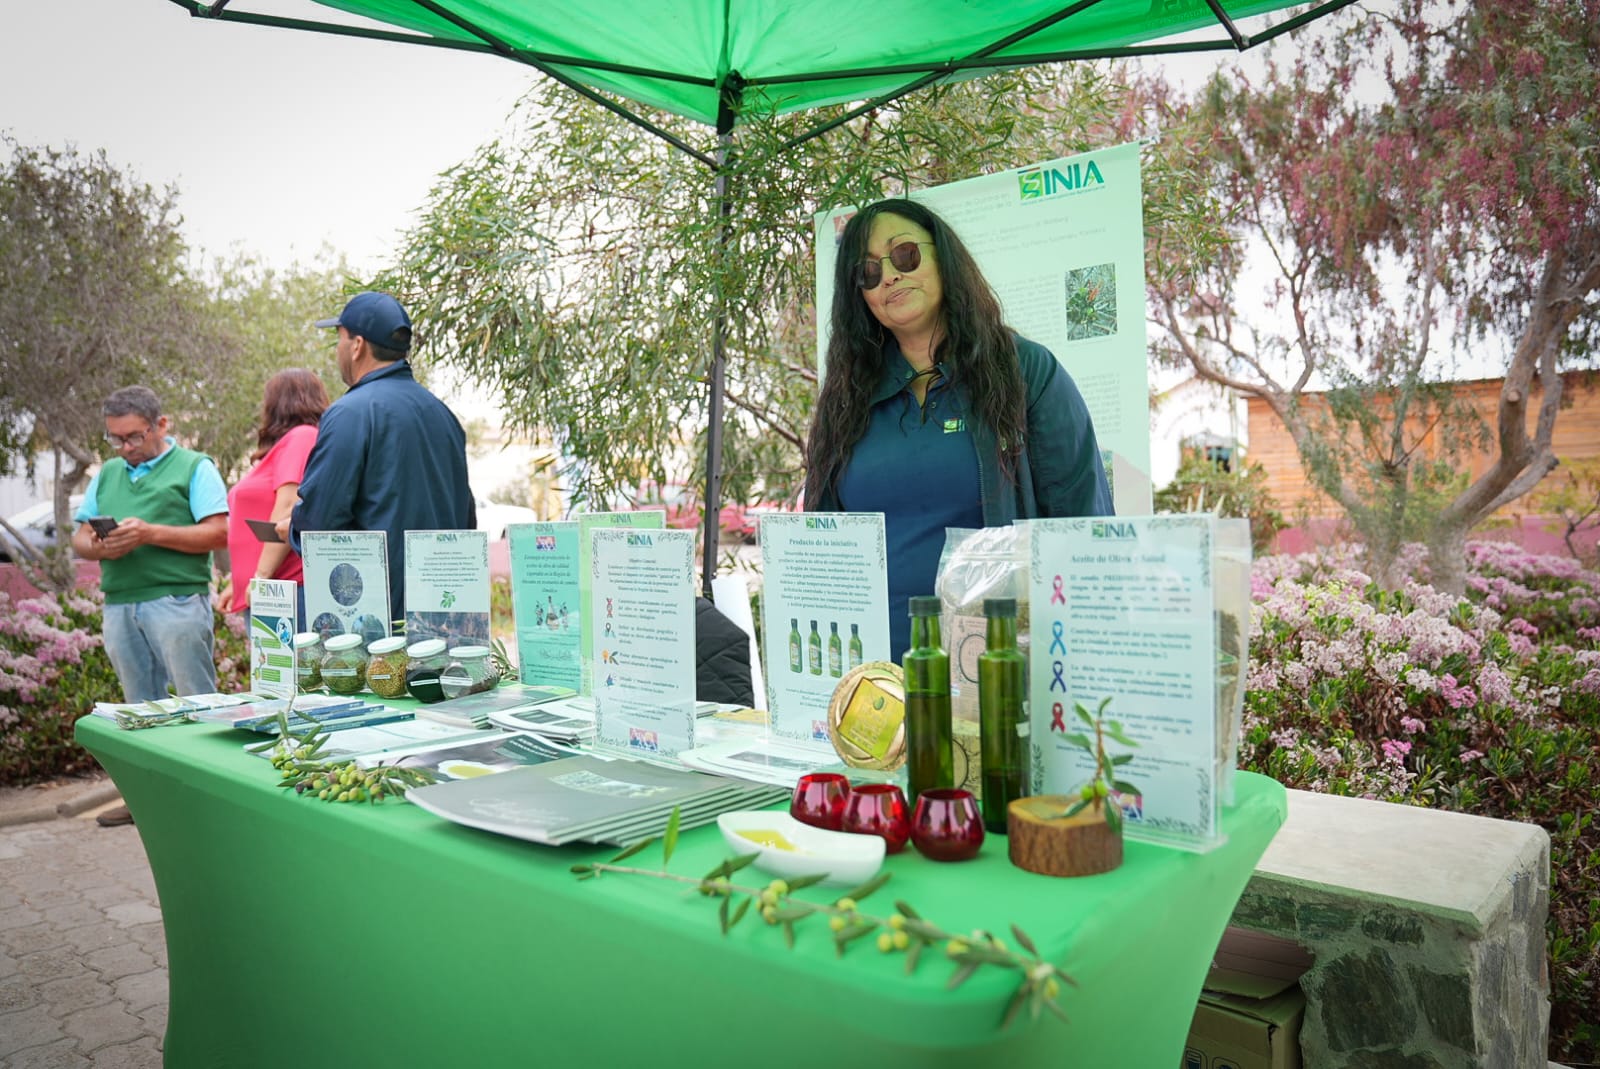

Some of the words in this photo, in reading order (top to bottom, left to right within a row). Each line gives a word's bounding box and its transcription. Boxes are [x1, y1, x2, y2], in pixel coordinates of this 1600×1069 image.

[1043, 160, 1104, 195] INIA
[815, 518, 837, 529] INIA
[1105, 522, 1137, 538] INIA
[634, 534, 653, 546] INIA
[1071, 554, 1095, 562] Aceite
[1108, 555, 1131, 563] Oliva
[267, 583, 285, 598] INIA
